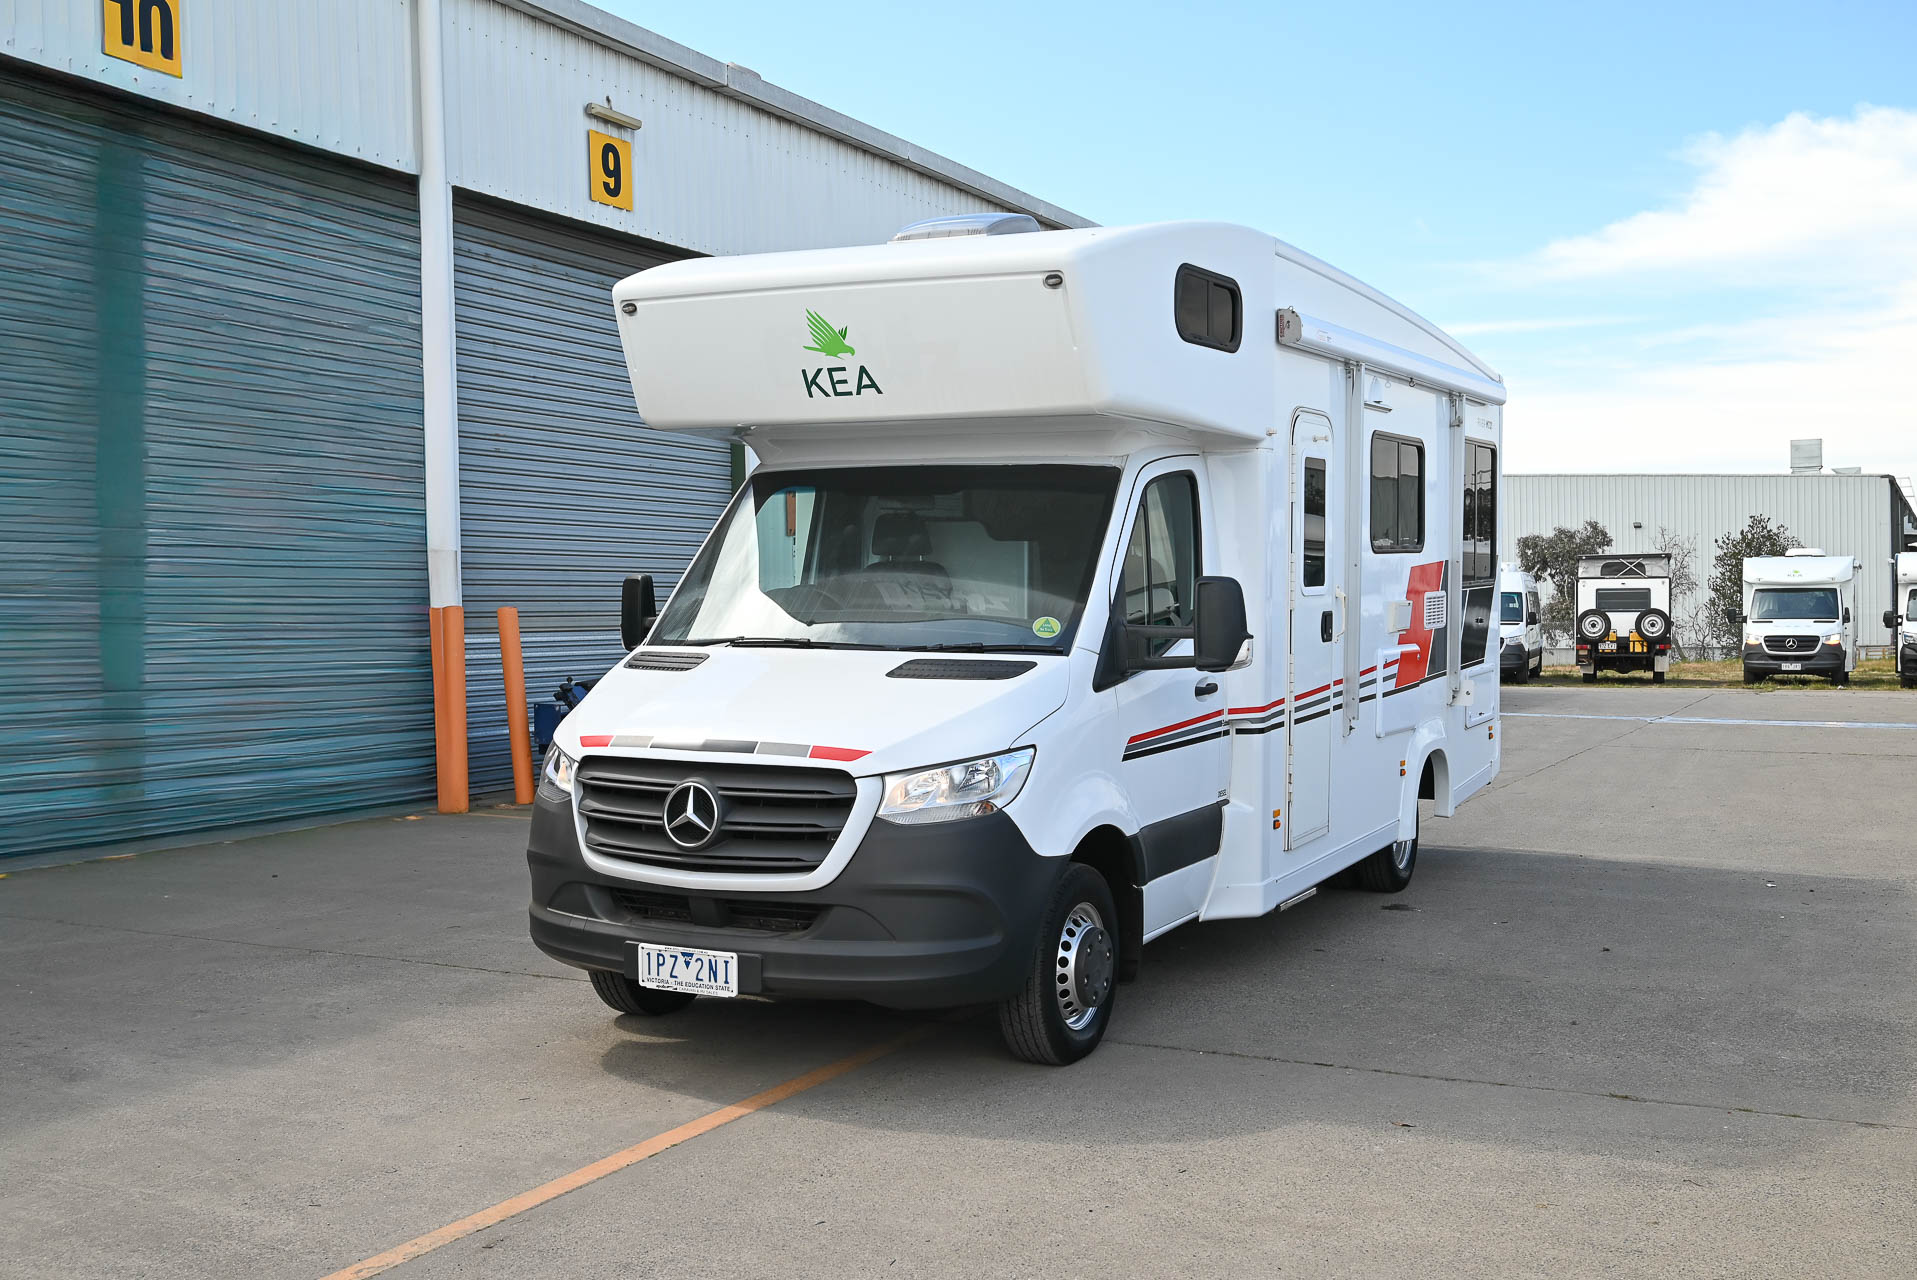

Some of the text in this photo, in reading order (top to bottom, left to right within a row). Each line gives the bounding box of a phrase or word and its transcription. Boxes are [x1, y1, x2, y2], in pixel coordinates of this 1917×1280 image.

[601, 142, 622, 198] 9
[801, 365, 884, 398] KEA
[685, 981, 714, 990] EDUCATION
[715, 984, 730, 992] STATE
